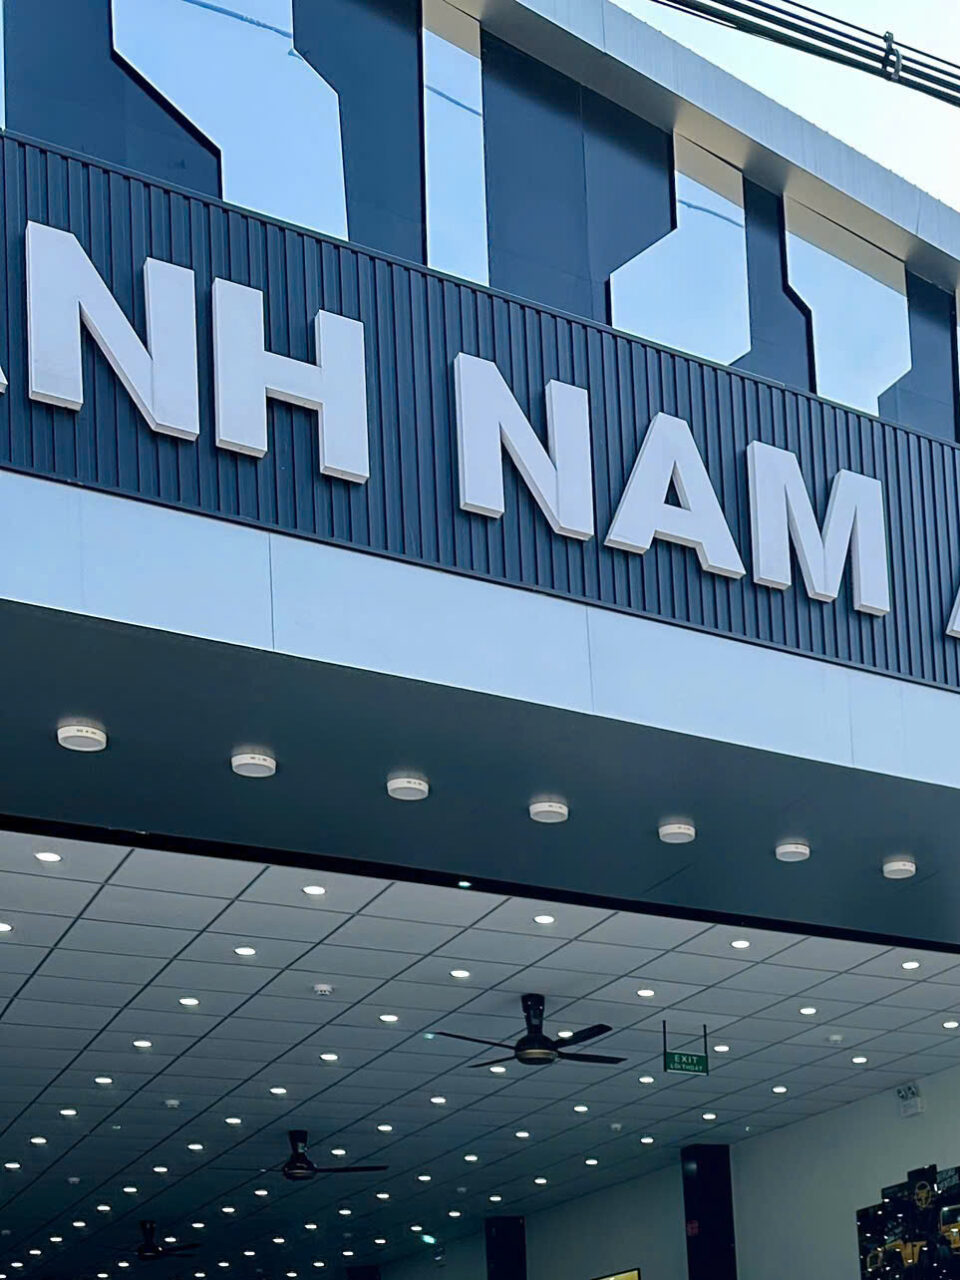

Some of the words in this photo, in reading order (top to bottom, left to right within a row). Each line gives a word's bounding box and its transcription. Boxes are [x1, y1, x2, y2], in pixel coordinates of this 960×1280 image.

[0, 220, 370, 484] NH
[454, 352, 890, 617] NAM
[674, 1054, 699, 1065] EXIT
